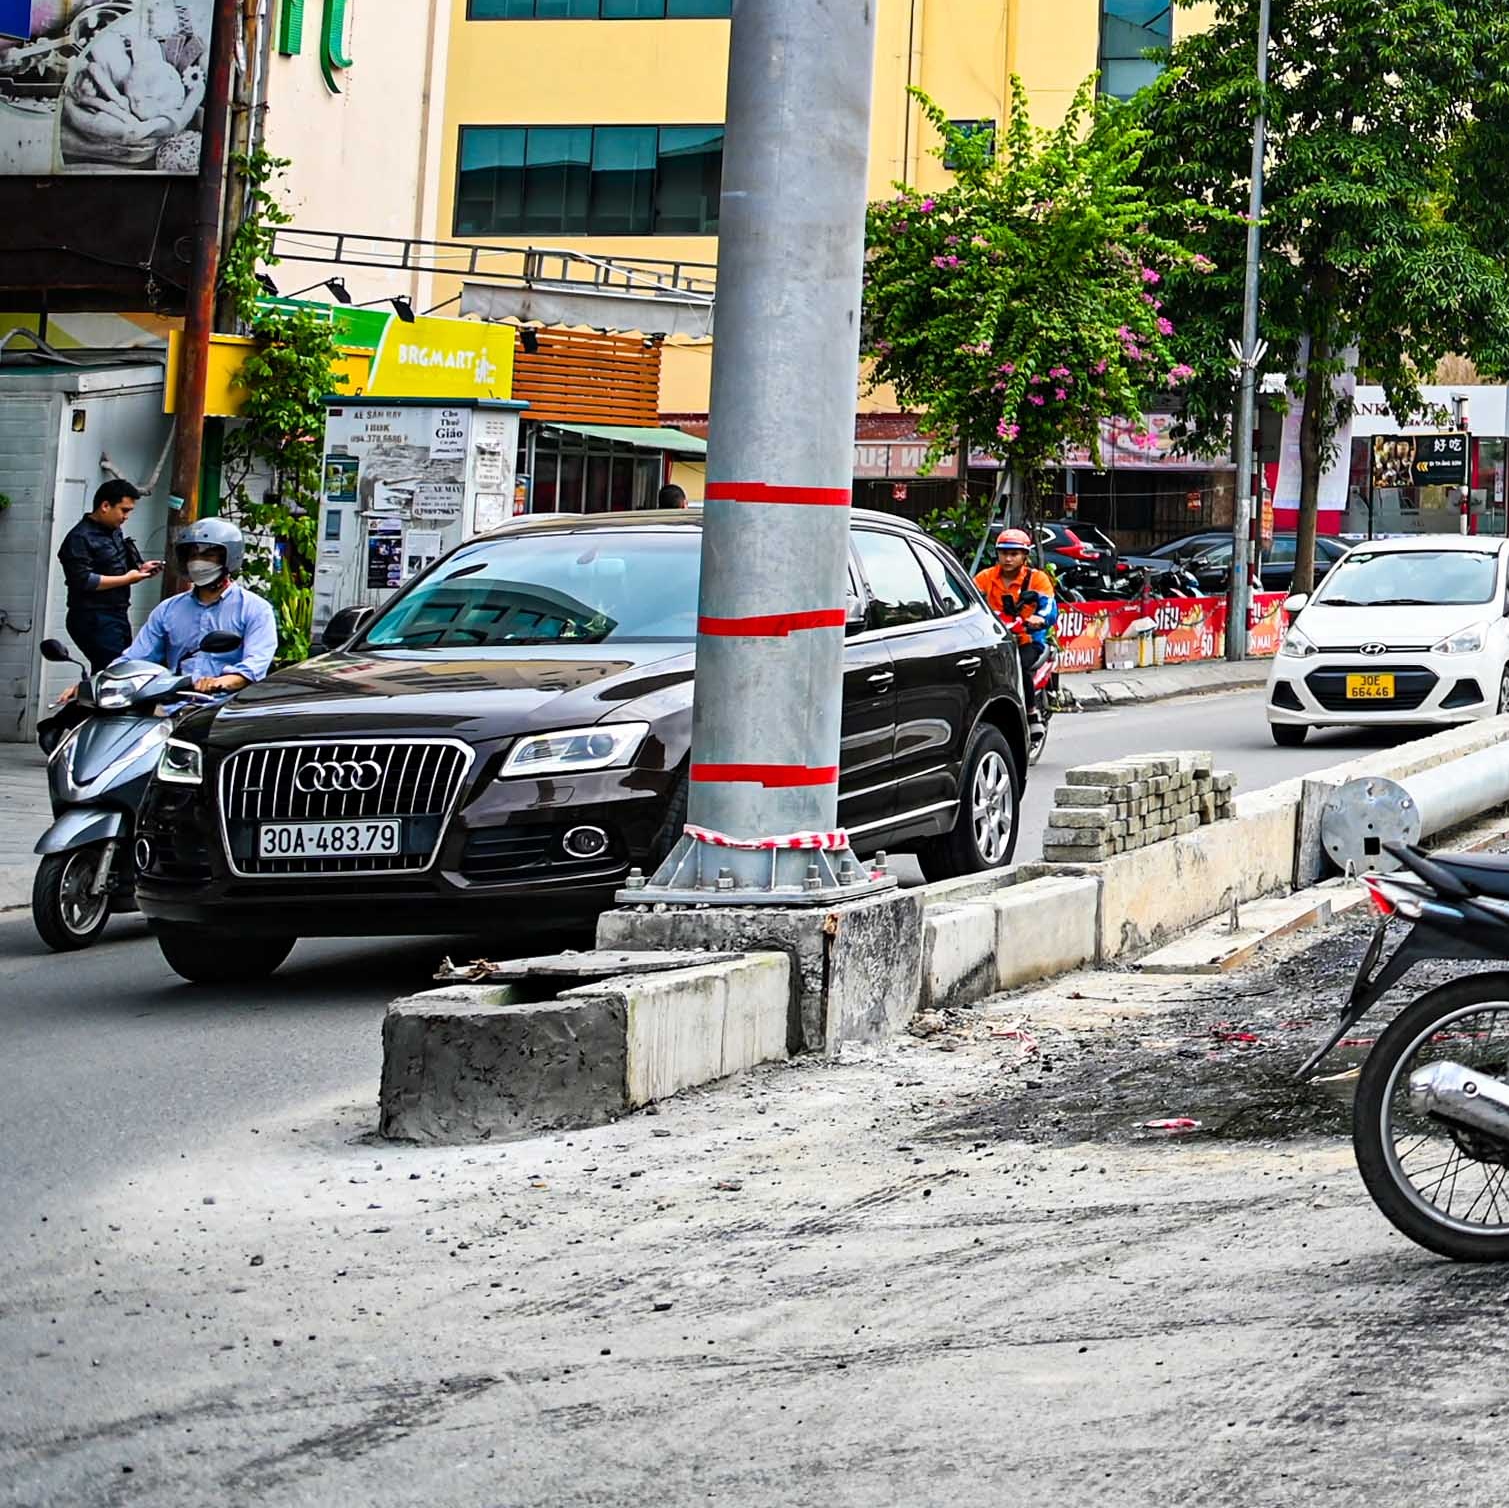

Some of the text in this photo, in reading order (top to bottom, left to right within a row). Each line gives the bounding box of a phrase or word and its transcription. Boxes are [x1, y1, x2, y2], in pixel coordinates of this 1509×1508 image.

[398, 343, 476, 371] BRGMART
[1201, 634, 1214, 656] 50
[1360, 675, 1381, 686] 30E
[1351, 687, 1389, 697] 664.46
[263, 824, 396, 854] 30A-483.79
